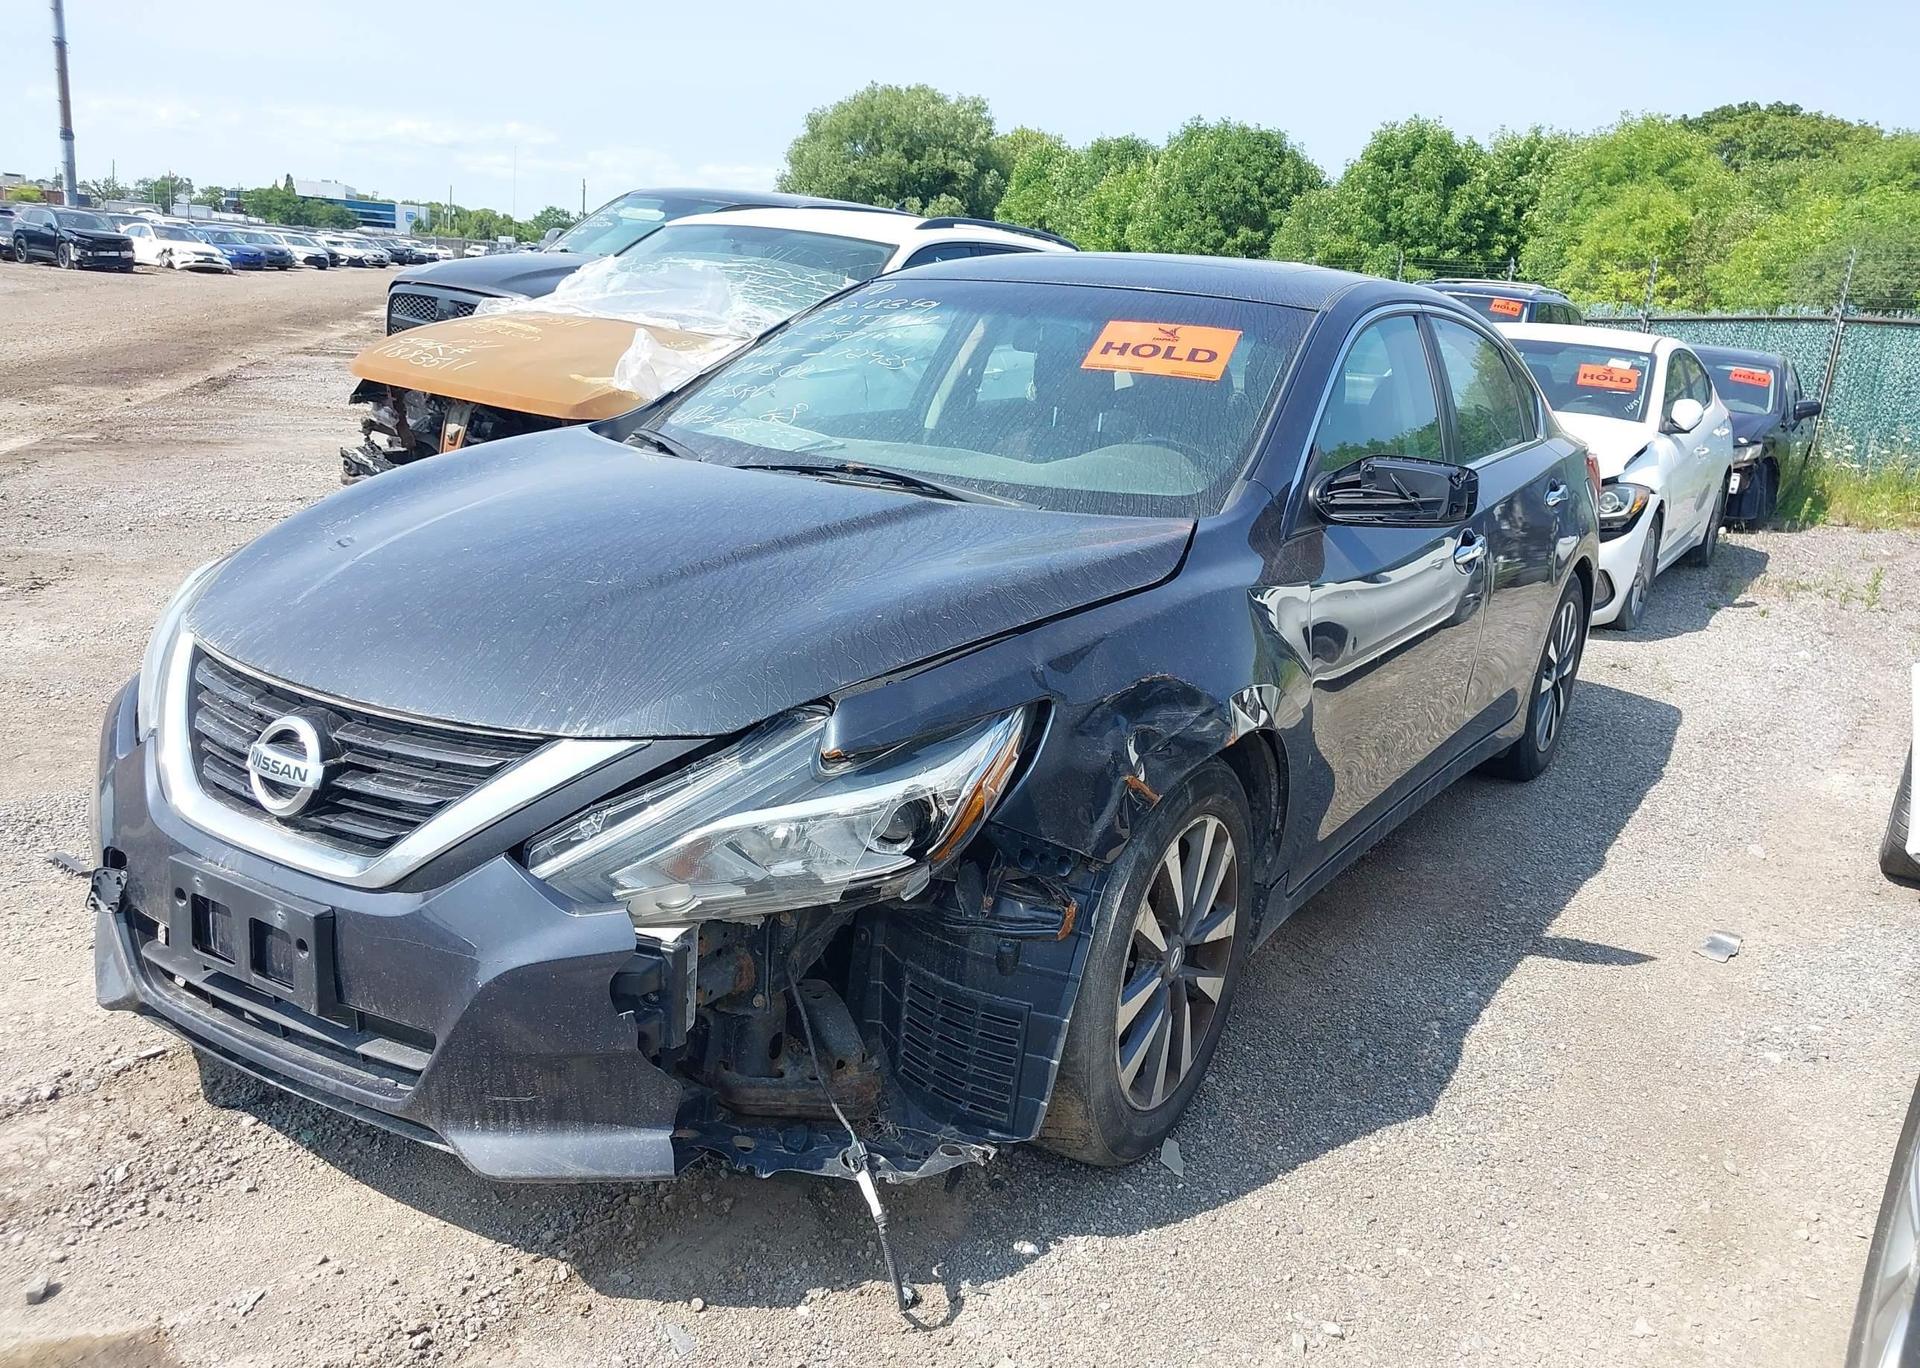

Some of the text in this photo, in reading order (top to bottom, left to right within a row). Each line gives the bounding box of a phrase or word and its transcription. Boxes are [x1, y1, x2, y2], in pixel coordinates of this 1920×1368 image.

[1494, 304, 1518, 312] HOLD
[1100, 341, 1218, 363] HOLD
[1583, 373, 1632, 384] HOLD
[1734, 373, 1766, 382] HOLD
[251, 751, 308, 782] NISSAN
